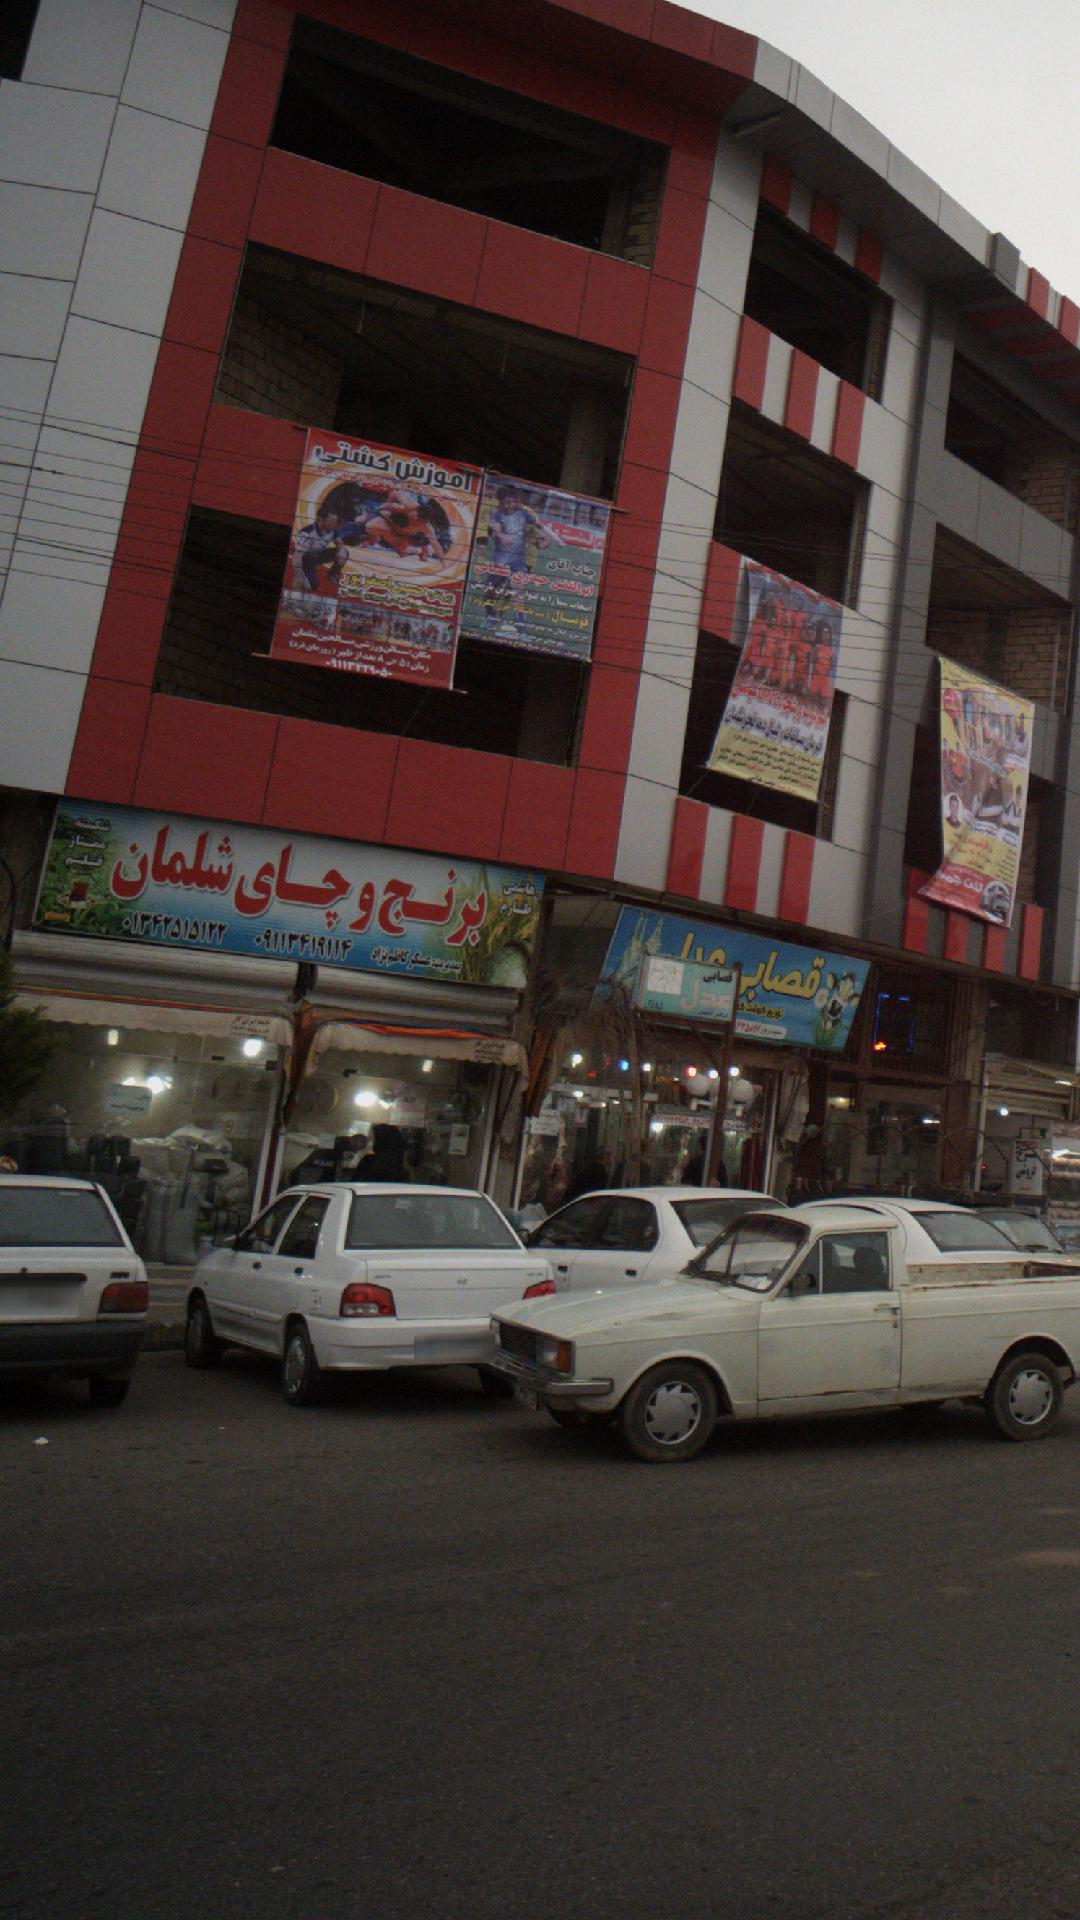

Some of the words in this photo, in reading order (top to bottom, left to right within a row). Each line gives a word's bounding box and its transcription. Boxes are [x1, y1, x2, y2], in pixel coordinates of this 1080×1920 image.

[314, 440, 391, 472] کشتی
[573, 564, 595, 578] جناب
[109, 824, 236, 900] شلمان
[234, 843, 352, 930] چای
[348, 877, 377, 932] و
[377, 867, 488, 947] برنج
[254, 931, 352, 962] ۰۹۱۱۳۴۱۹۱۱۴
[703, 969, 733, 984] قصابی
[738, 950, 825, 1001] قصاب
